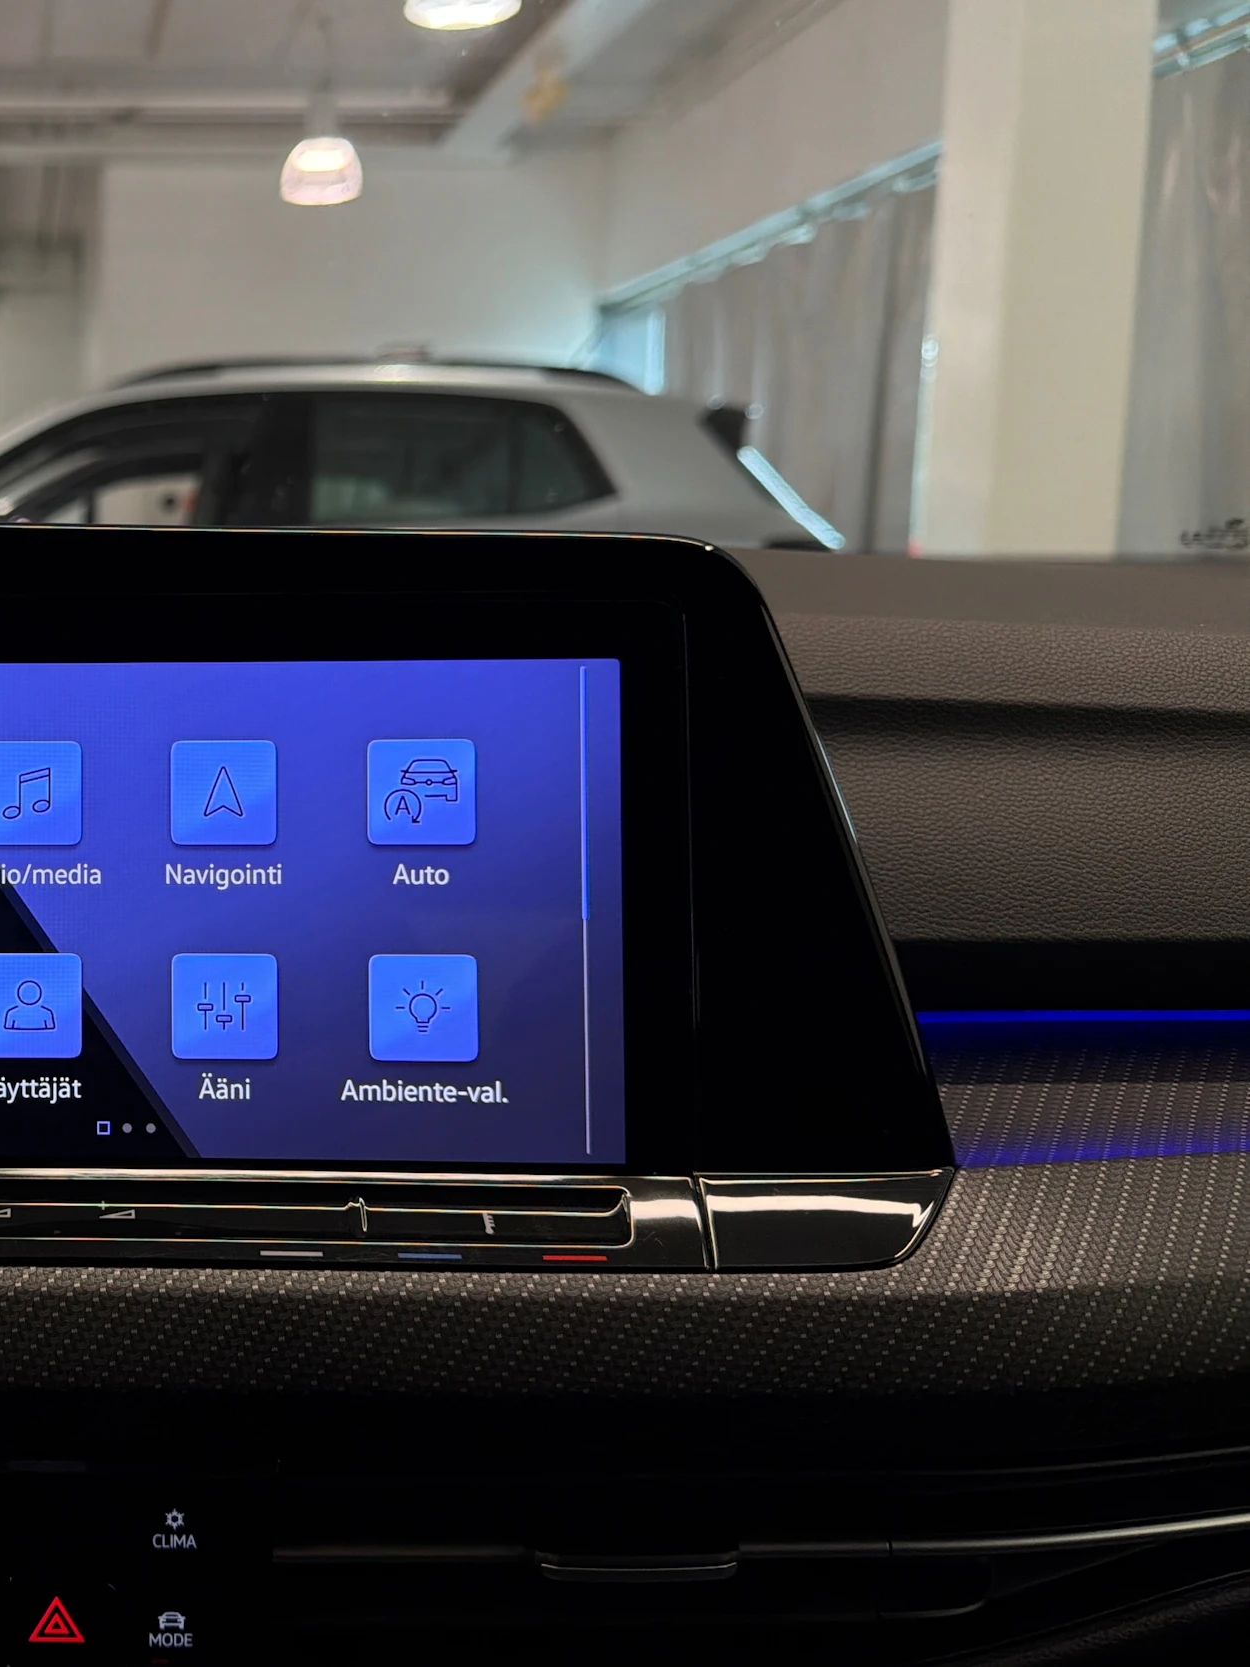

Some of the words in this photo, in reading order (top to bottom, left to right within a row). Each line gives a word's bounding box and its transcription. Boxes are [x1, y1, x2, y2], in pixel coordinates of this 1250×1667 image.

[164, 862, 283, 891] Navigointi
[392, 862, 451, 887] Auto
[197, 1071, 252, 1101] Ääni
[340, 1079, 510, 1105] Ambiente-val.
[152, 1533, 198, 1550] CLIMA
[148, 1632, 194, 1649] MODE
